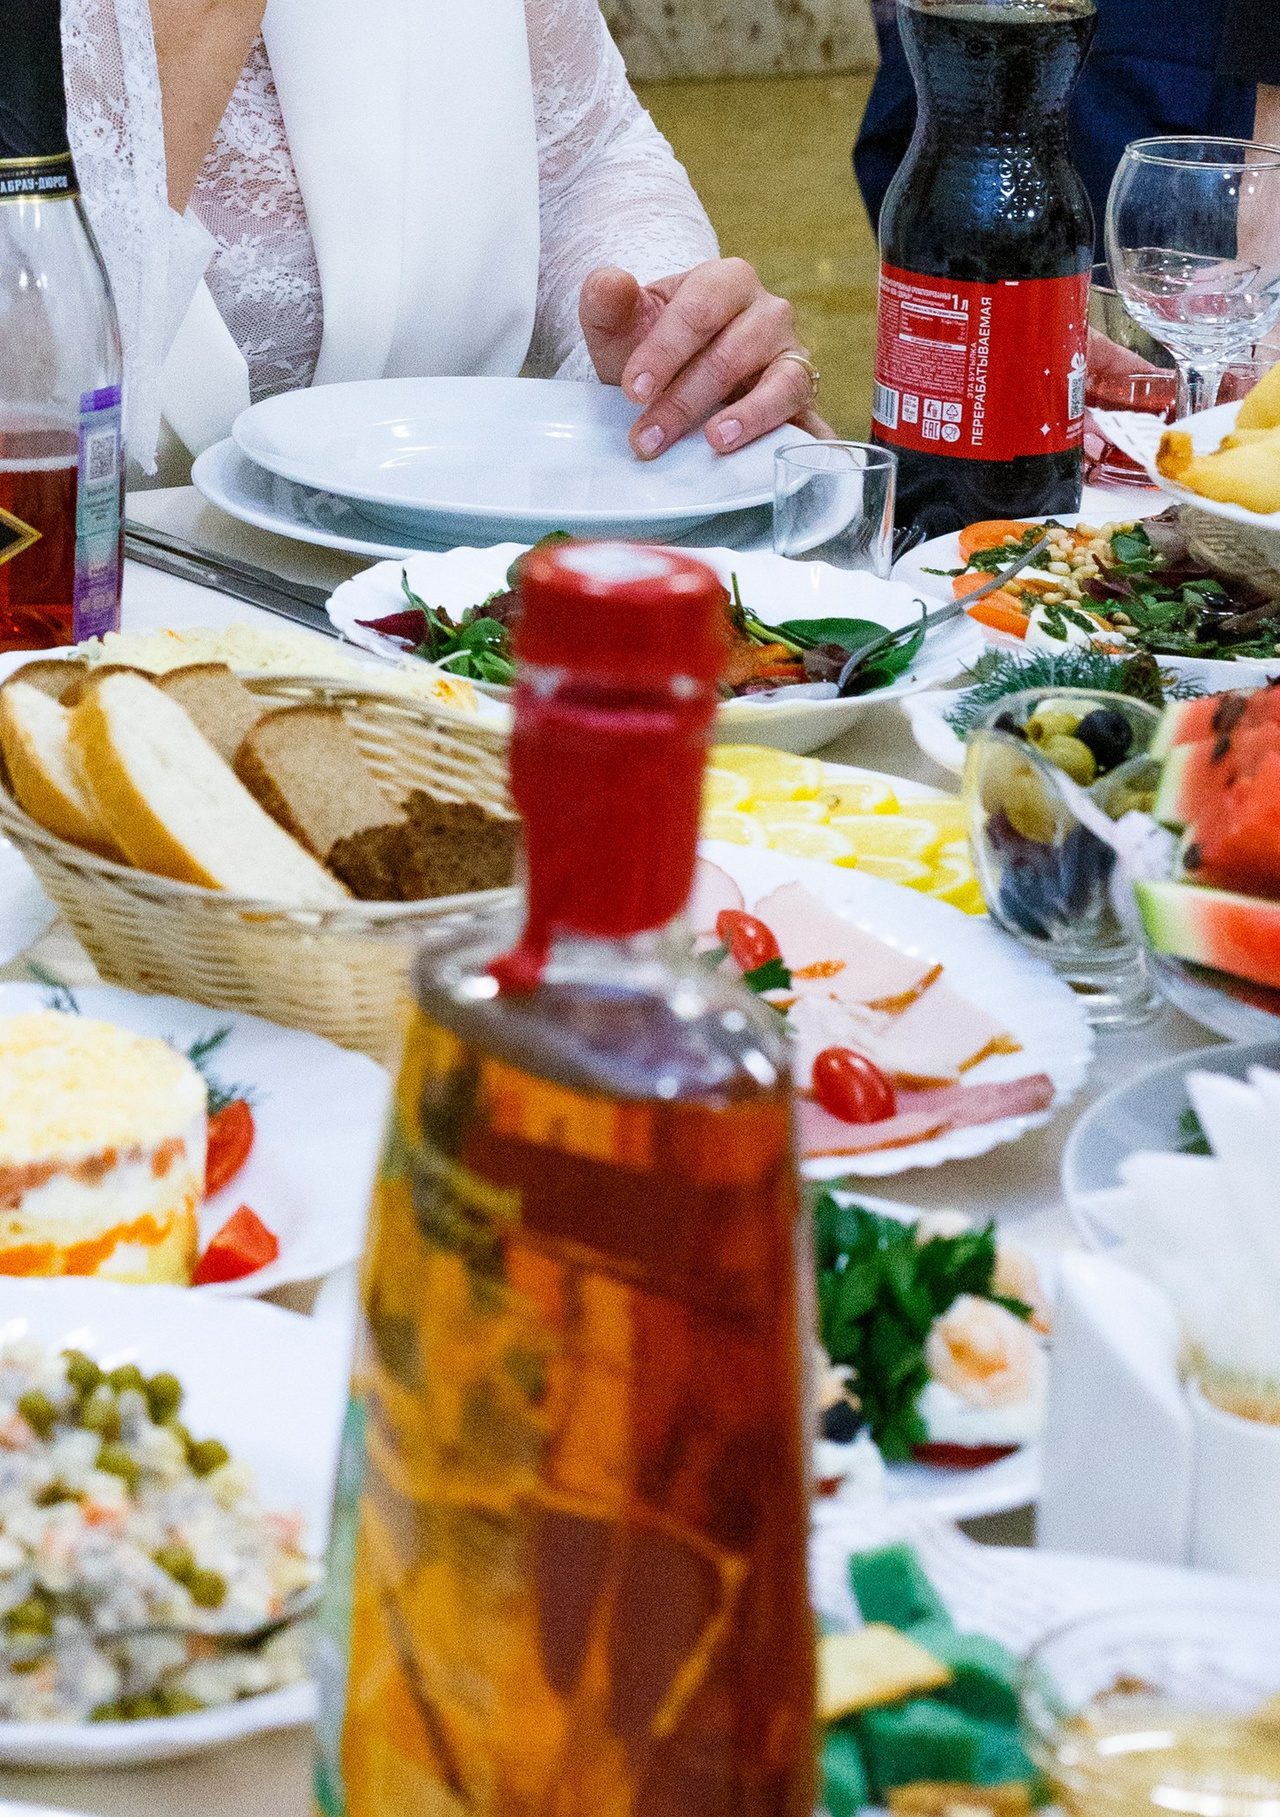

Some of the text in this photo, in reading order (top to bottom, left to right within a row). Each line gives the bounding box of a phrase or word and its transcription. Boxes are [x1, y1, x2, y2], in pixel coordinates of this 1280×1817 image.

[951, 294, 959, 310] 1
[968, 342, 978, 382] БУТЫЛКА
[971, 296, 993, 446] ПЕРЕРАБАТЫВАЕМАЯ
